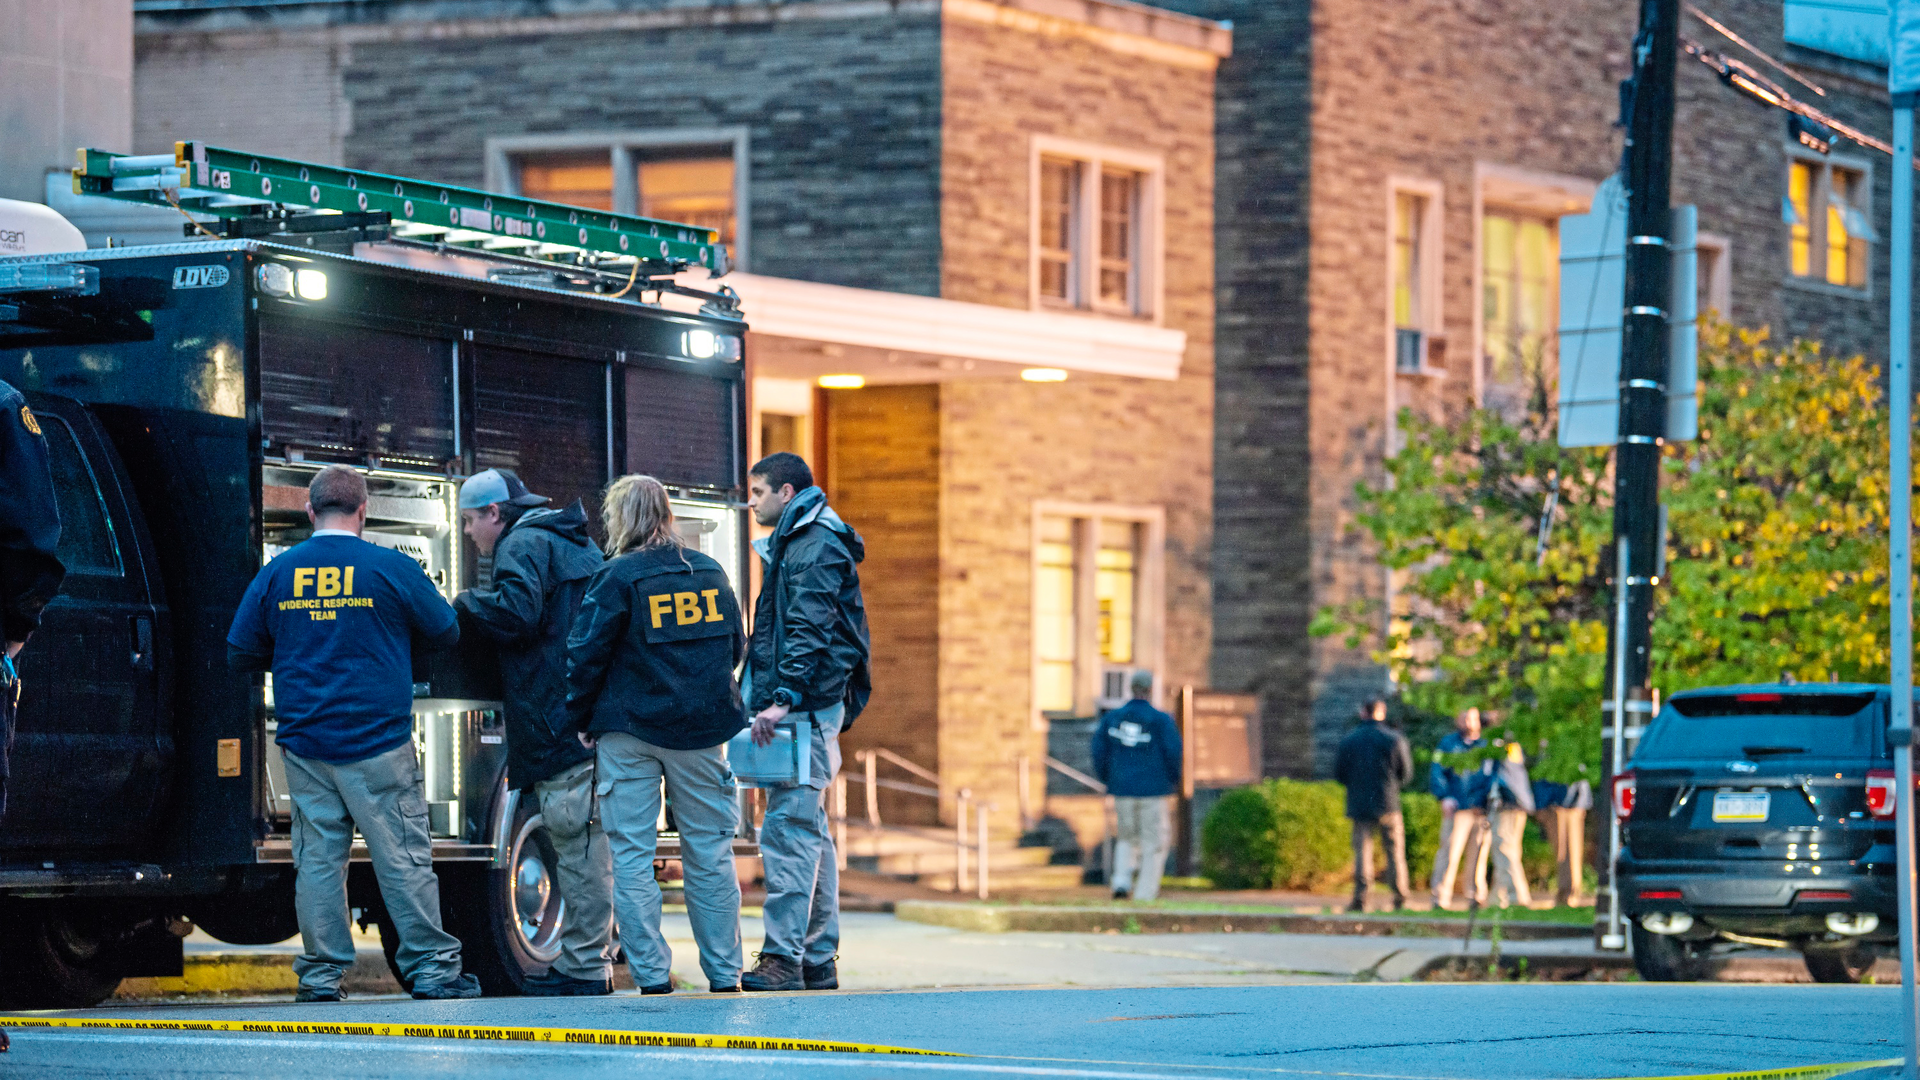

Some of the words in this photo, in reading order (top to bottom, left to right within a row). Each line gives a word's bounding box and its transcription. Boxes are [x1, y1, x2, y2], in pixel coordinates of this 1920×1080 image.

[174, 268, 213, 287] LDV
[293, 565, 355, 597] FBI
[323, 598, 374, 608] RESPONSE
[648, 588, 724, 629] FBI
[309, 610, 336, 621] TEAM
